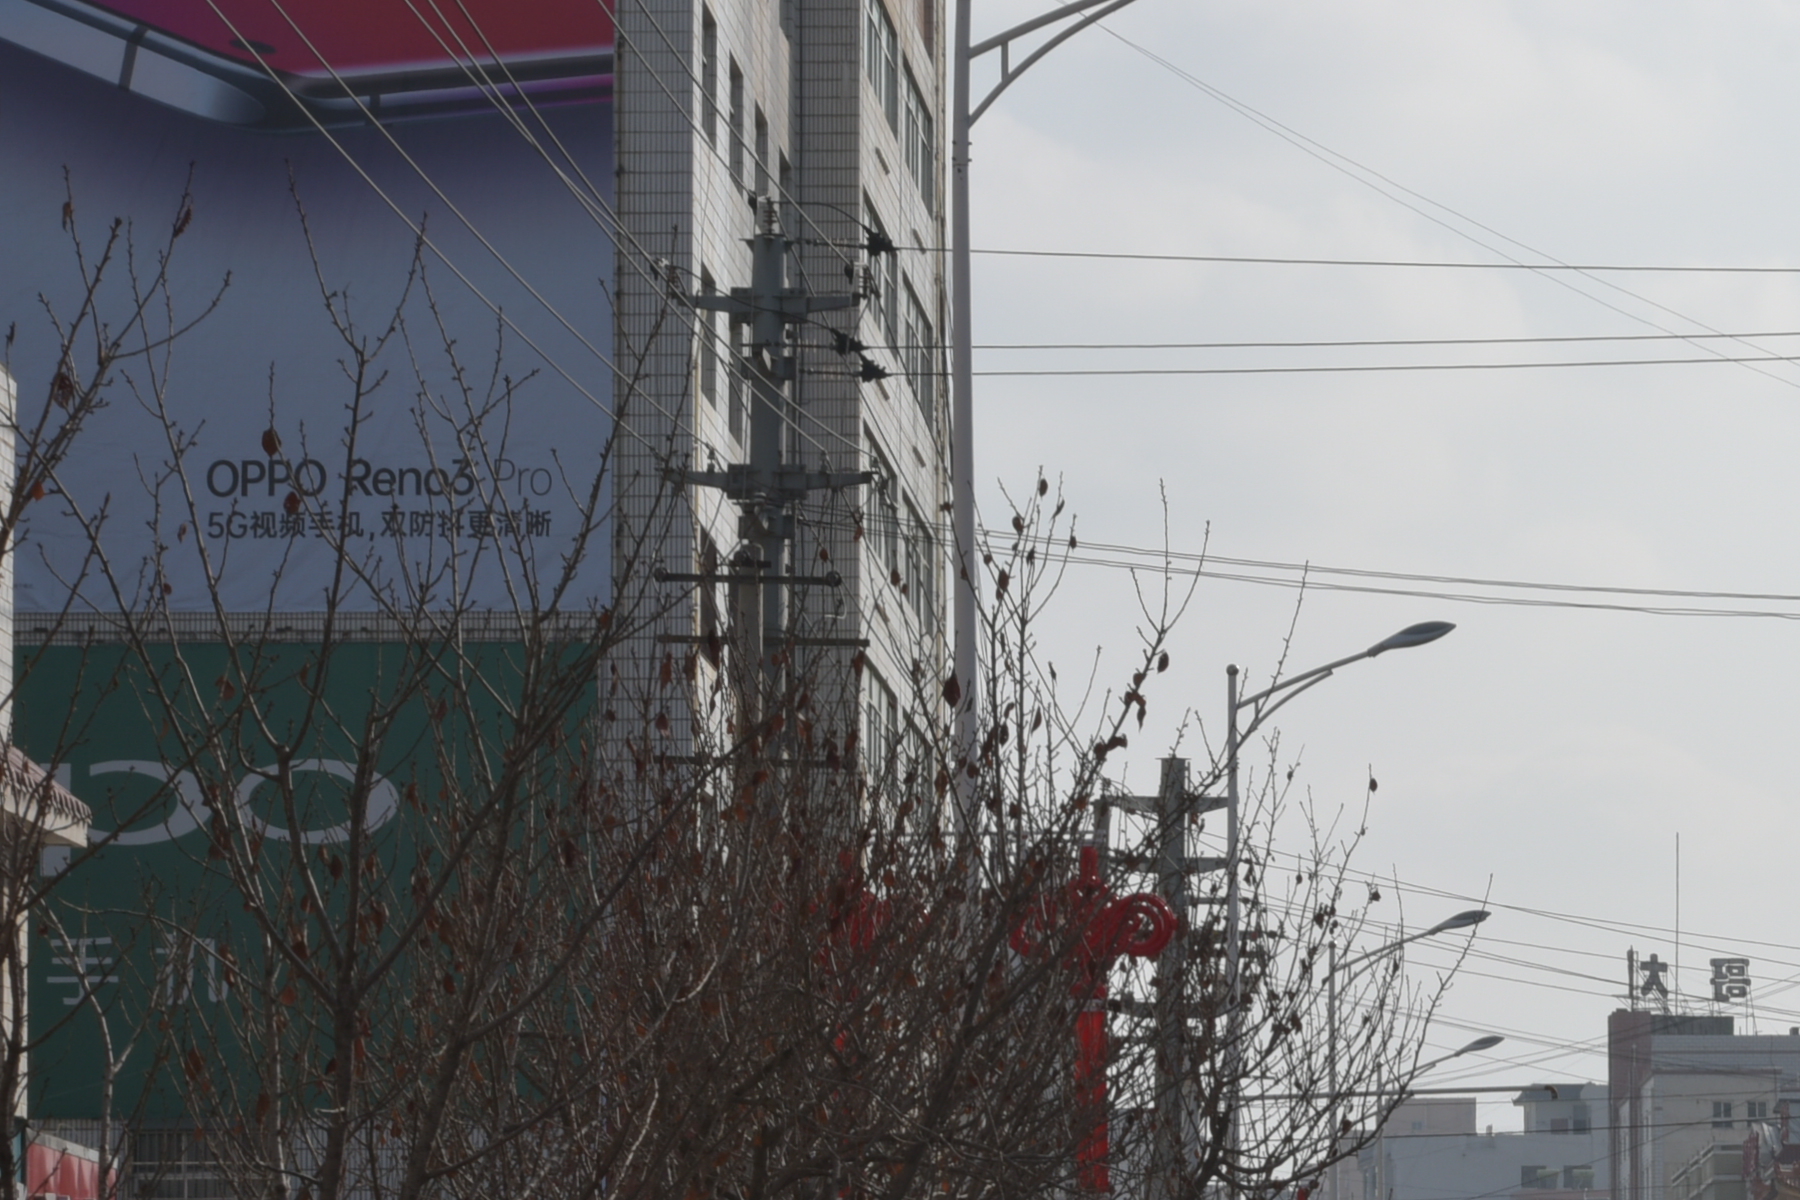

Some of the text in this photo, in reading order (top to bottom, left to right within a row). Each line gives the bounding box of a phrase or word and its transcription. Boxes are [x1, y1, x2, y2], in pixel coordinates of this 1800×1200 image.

[206, 458, 552, 497] OPPO Reno3 Pro
